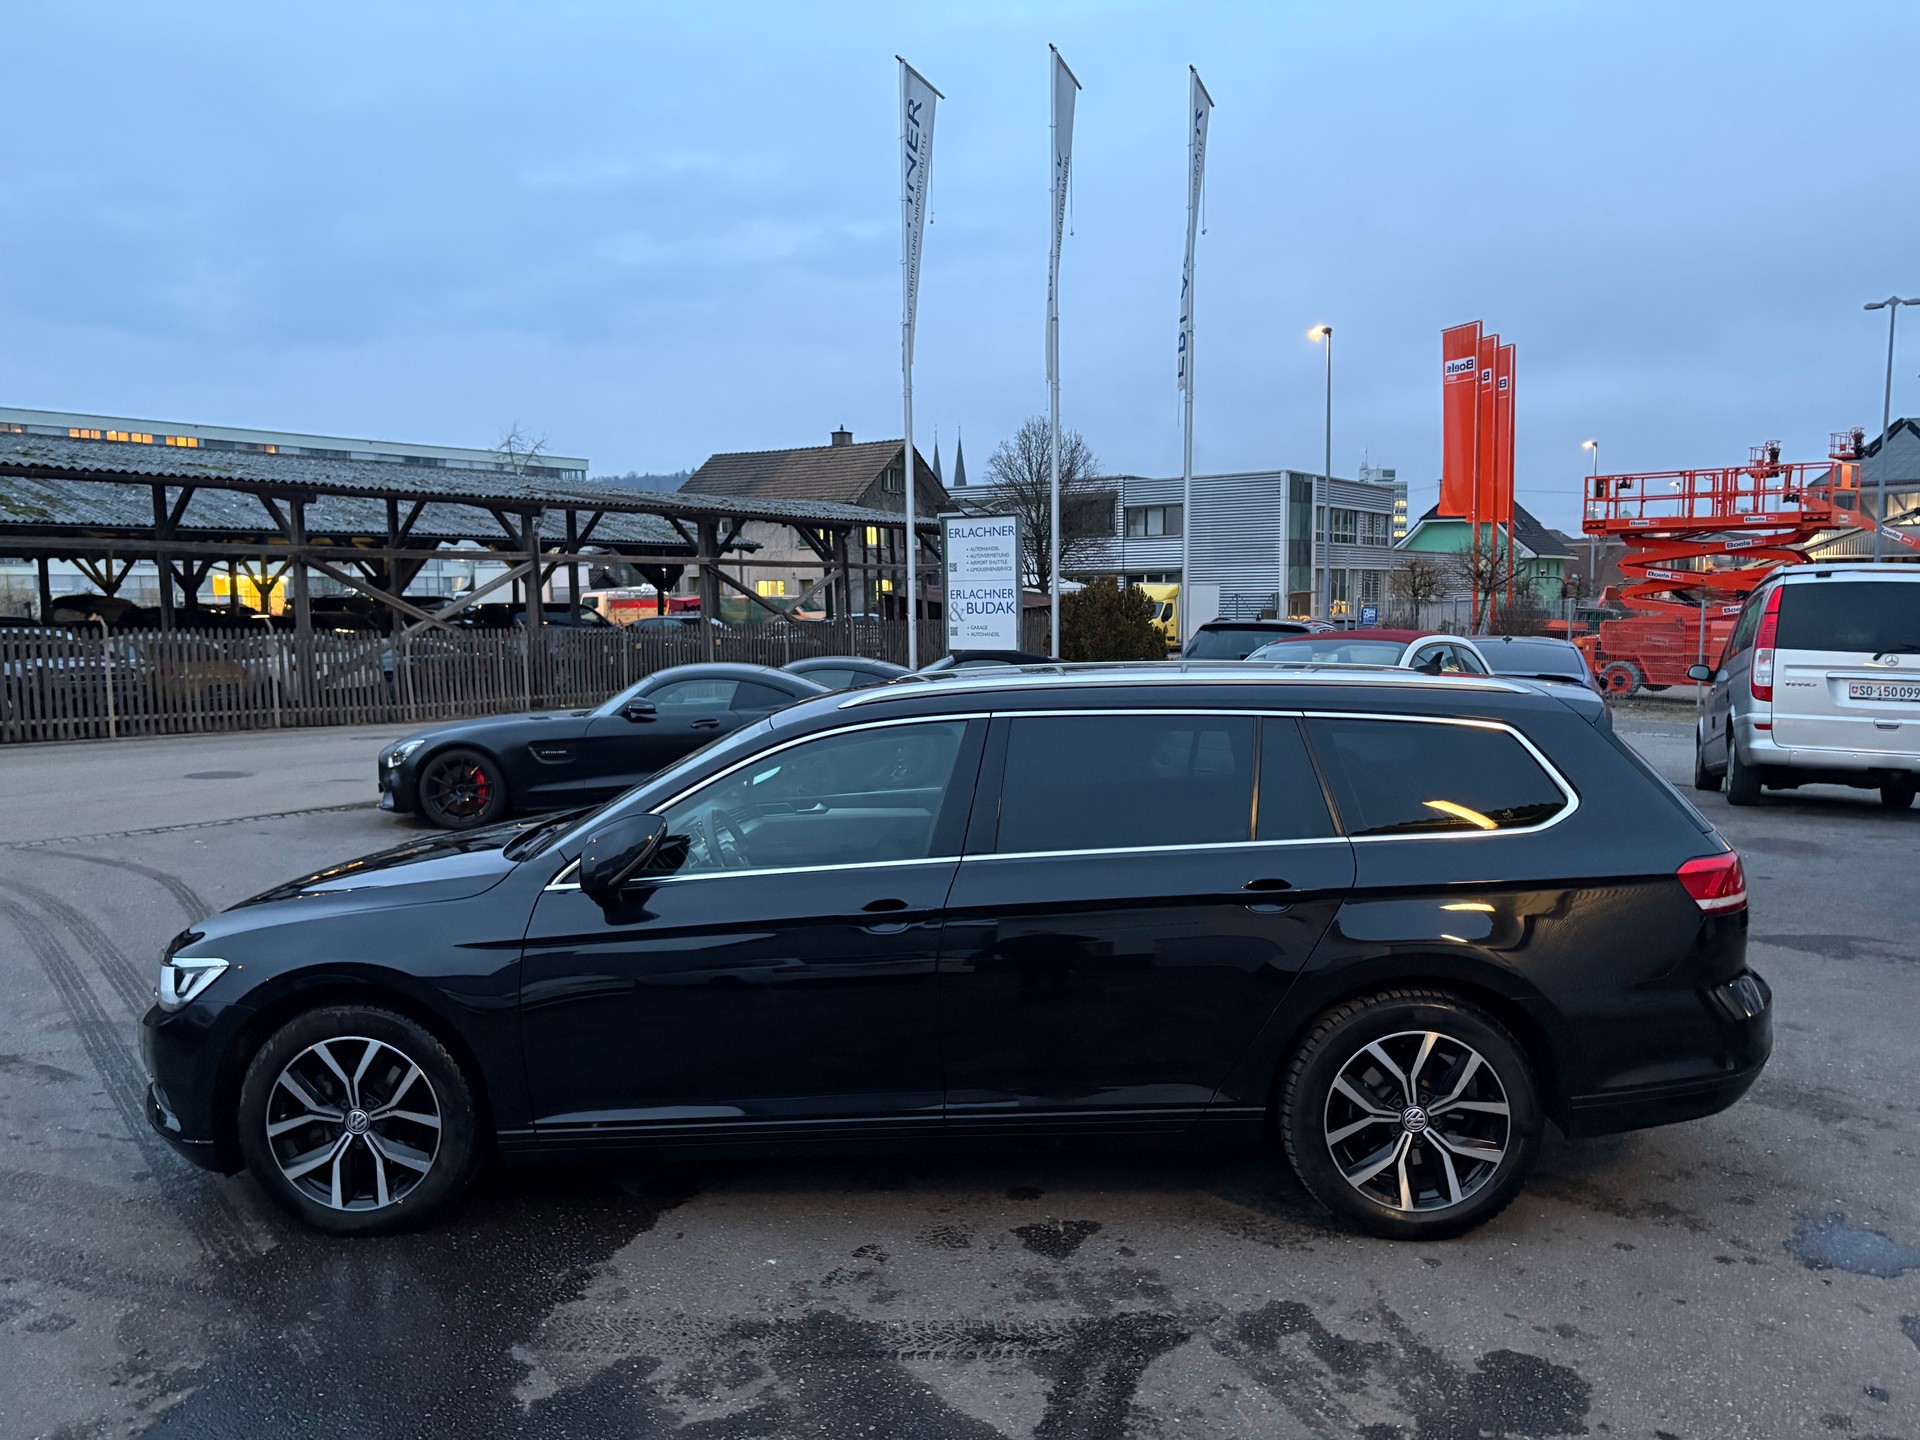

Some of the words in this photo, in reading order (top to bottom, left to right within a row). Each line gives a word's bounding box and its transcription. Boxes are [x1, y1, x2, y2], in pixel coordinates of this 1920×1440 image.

[948, 525, 1016, 539] ERLACHNER
[1726, 540, 1751, 549] Boels
[1647, 571, 1670, 579] Boels
[950, 588, 1015, 600] ERLACHNER
[949, 601, 966, 622] &
[966, 601, 1016, 615] BUDAK
